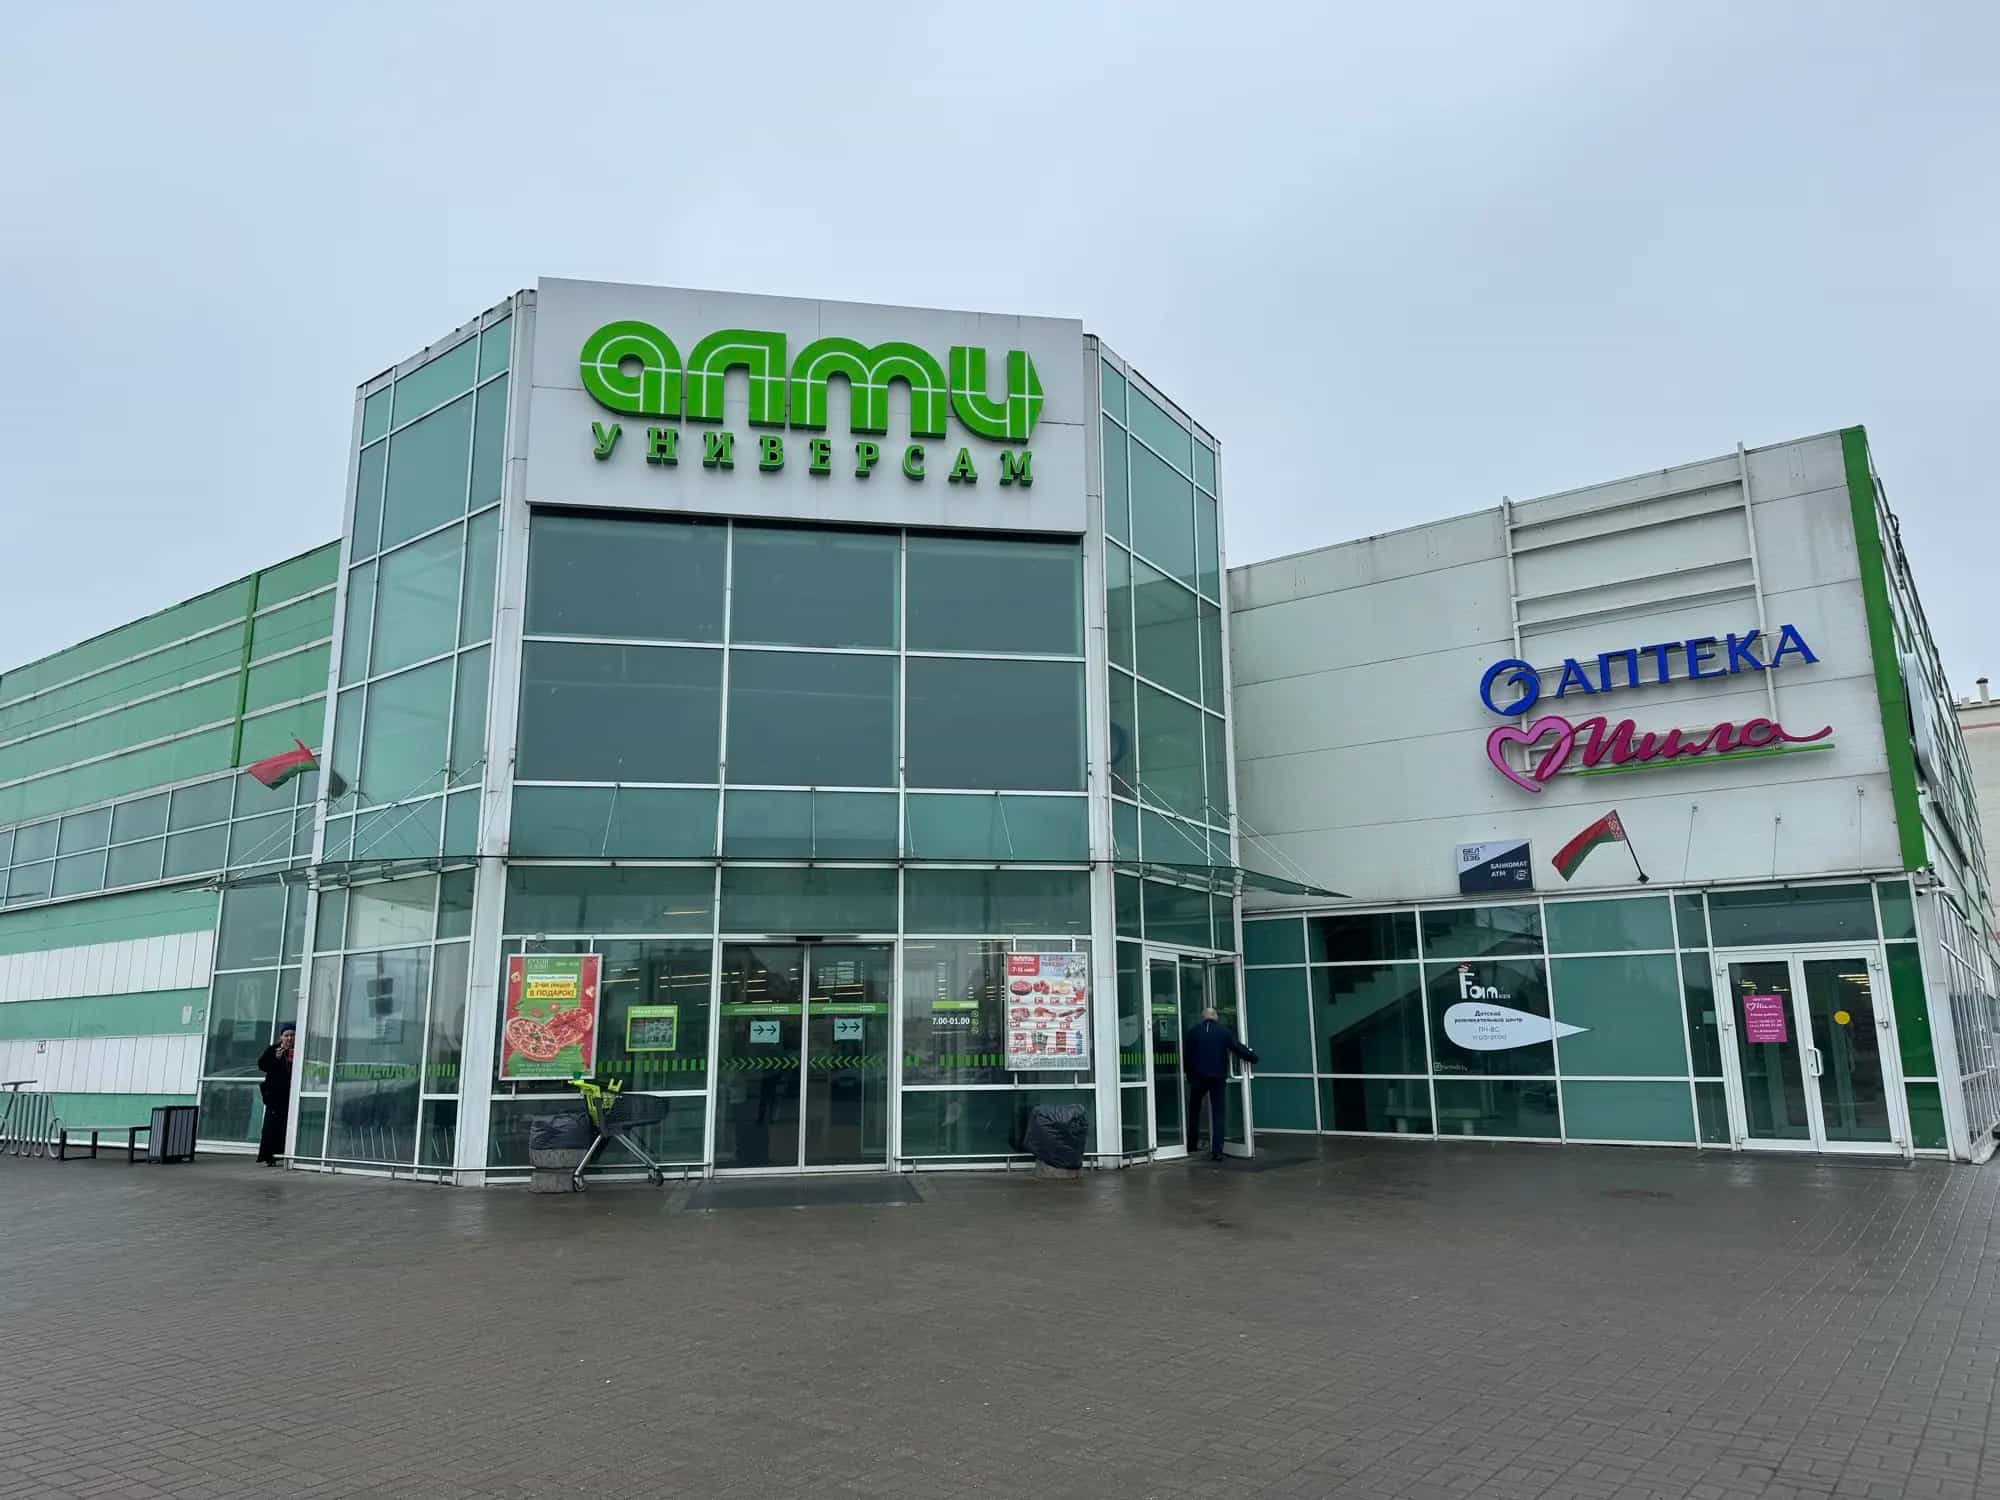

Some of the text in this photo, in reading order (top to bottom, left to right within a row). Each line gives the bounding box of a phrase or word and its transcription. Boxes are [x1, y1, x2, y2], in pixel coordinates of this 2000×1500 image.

[591, 421, 1033, 487] УНИВЕРСАМ
[1556, 624, 1820, 698] АПТЕКА
[1535, 715, 1833, 782] Мила
[1490, 861, 1528, 869] БАНКОМАТ
[932, 1016, 970, 1025] 7.00-01.00
